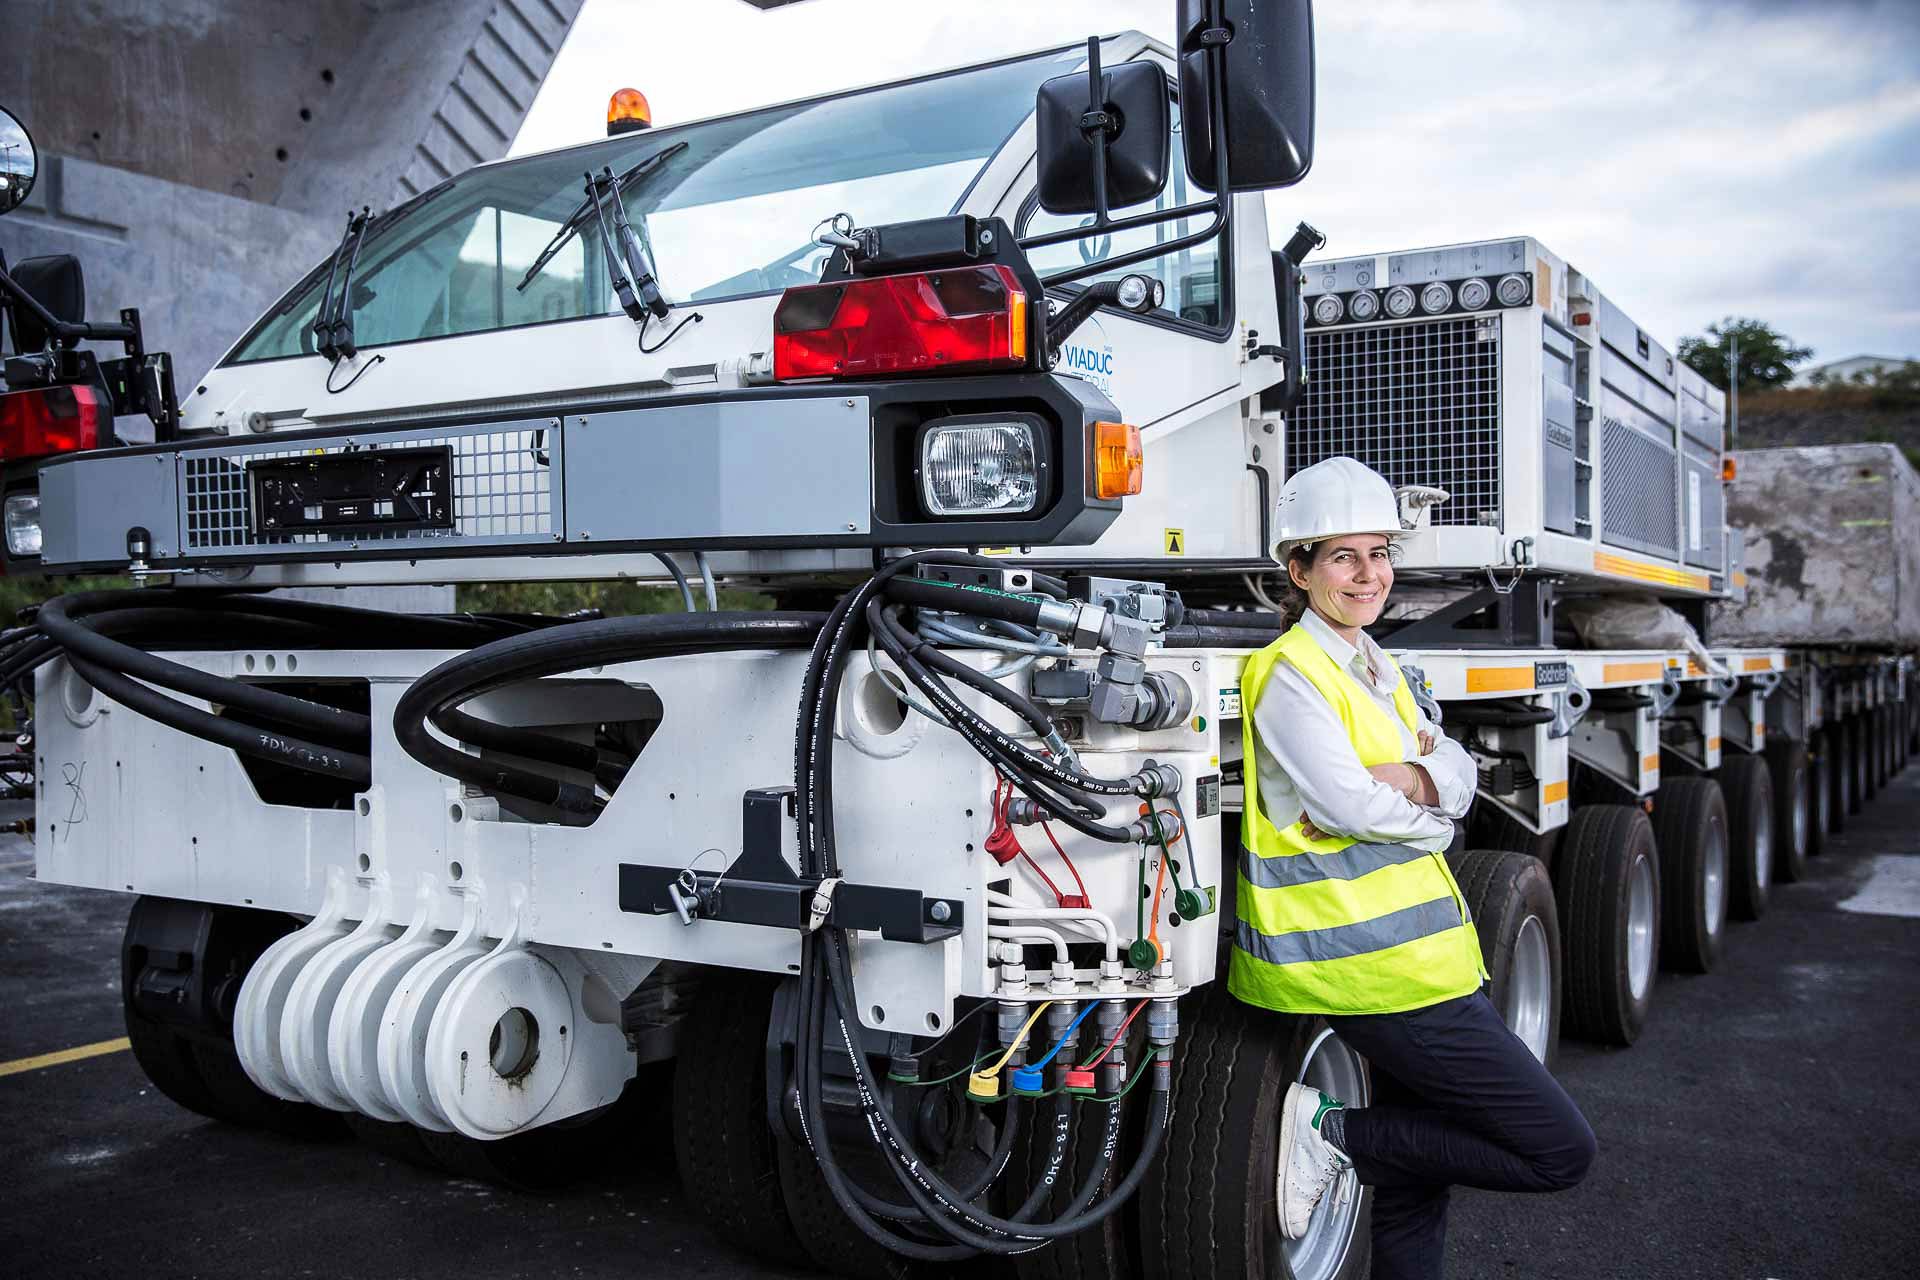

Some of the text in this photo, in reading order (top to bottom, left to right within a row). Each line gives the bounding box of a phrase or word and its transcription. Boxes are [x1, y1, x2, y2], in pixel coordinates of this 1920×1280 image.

[1065, 344, 1113, 376] VIADUC
[921, 675, 962, 713] SEMPERSHIELD
[977, 722, 992, 736] SSK
[996, 735, 1008, 747] DN
[1009, 743, 1018, 753] 12
[1042, 762, 1054, 772] WP
[1054, 768, 1065, 778] 345
[1065, 773, 1079, 784] BAR
[957, 721, 974, 740] MSHA
[1150, 860, 1159, 872] R
[1161, 887, 1168, 899] Y
[839, 1018, 860, 1074] SEMPERSHIELD
[874, 1111, 882, 1122] DN
[1045, 1114, 1068, 1185] L78-340
[1104, 1101, 1118, 1158] L78-340
